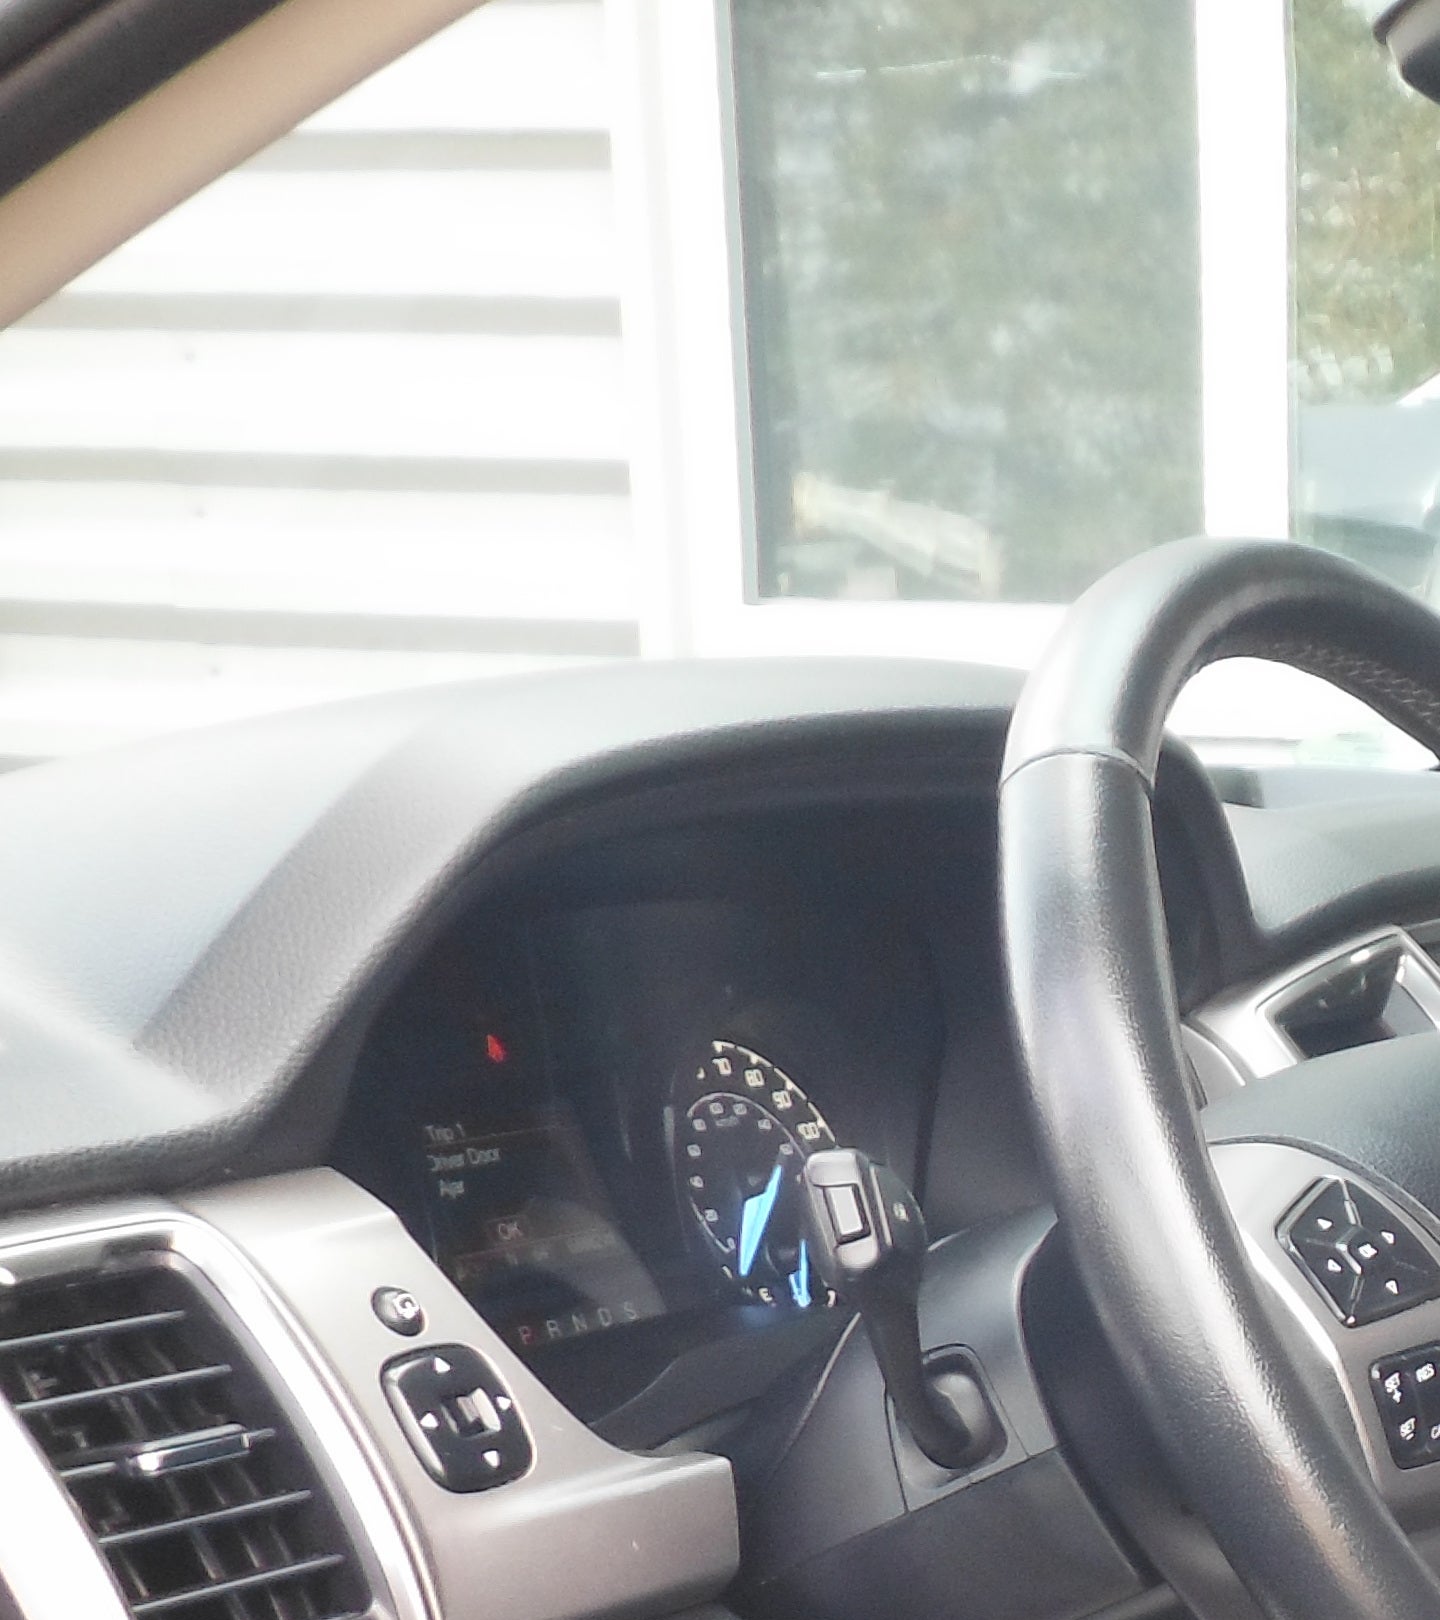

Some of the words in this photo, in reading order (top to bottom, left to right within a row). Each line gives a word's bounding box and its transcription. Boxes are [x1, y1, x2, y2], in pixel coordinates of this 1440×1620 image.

[546, 1319, 562, 1338] R
[572, 1314, 587, 1332] N
[597, 1307, 613, 1327] D
[623, 1301, 638, 1320] S
